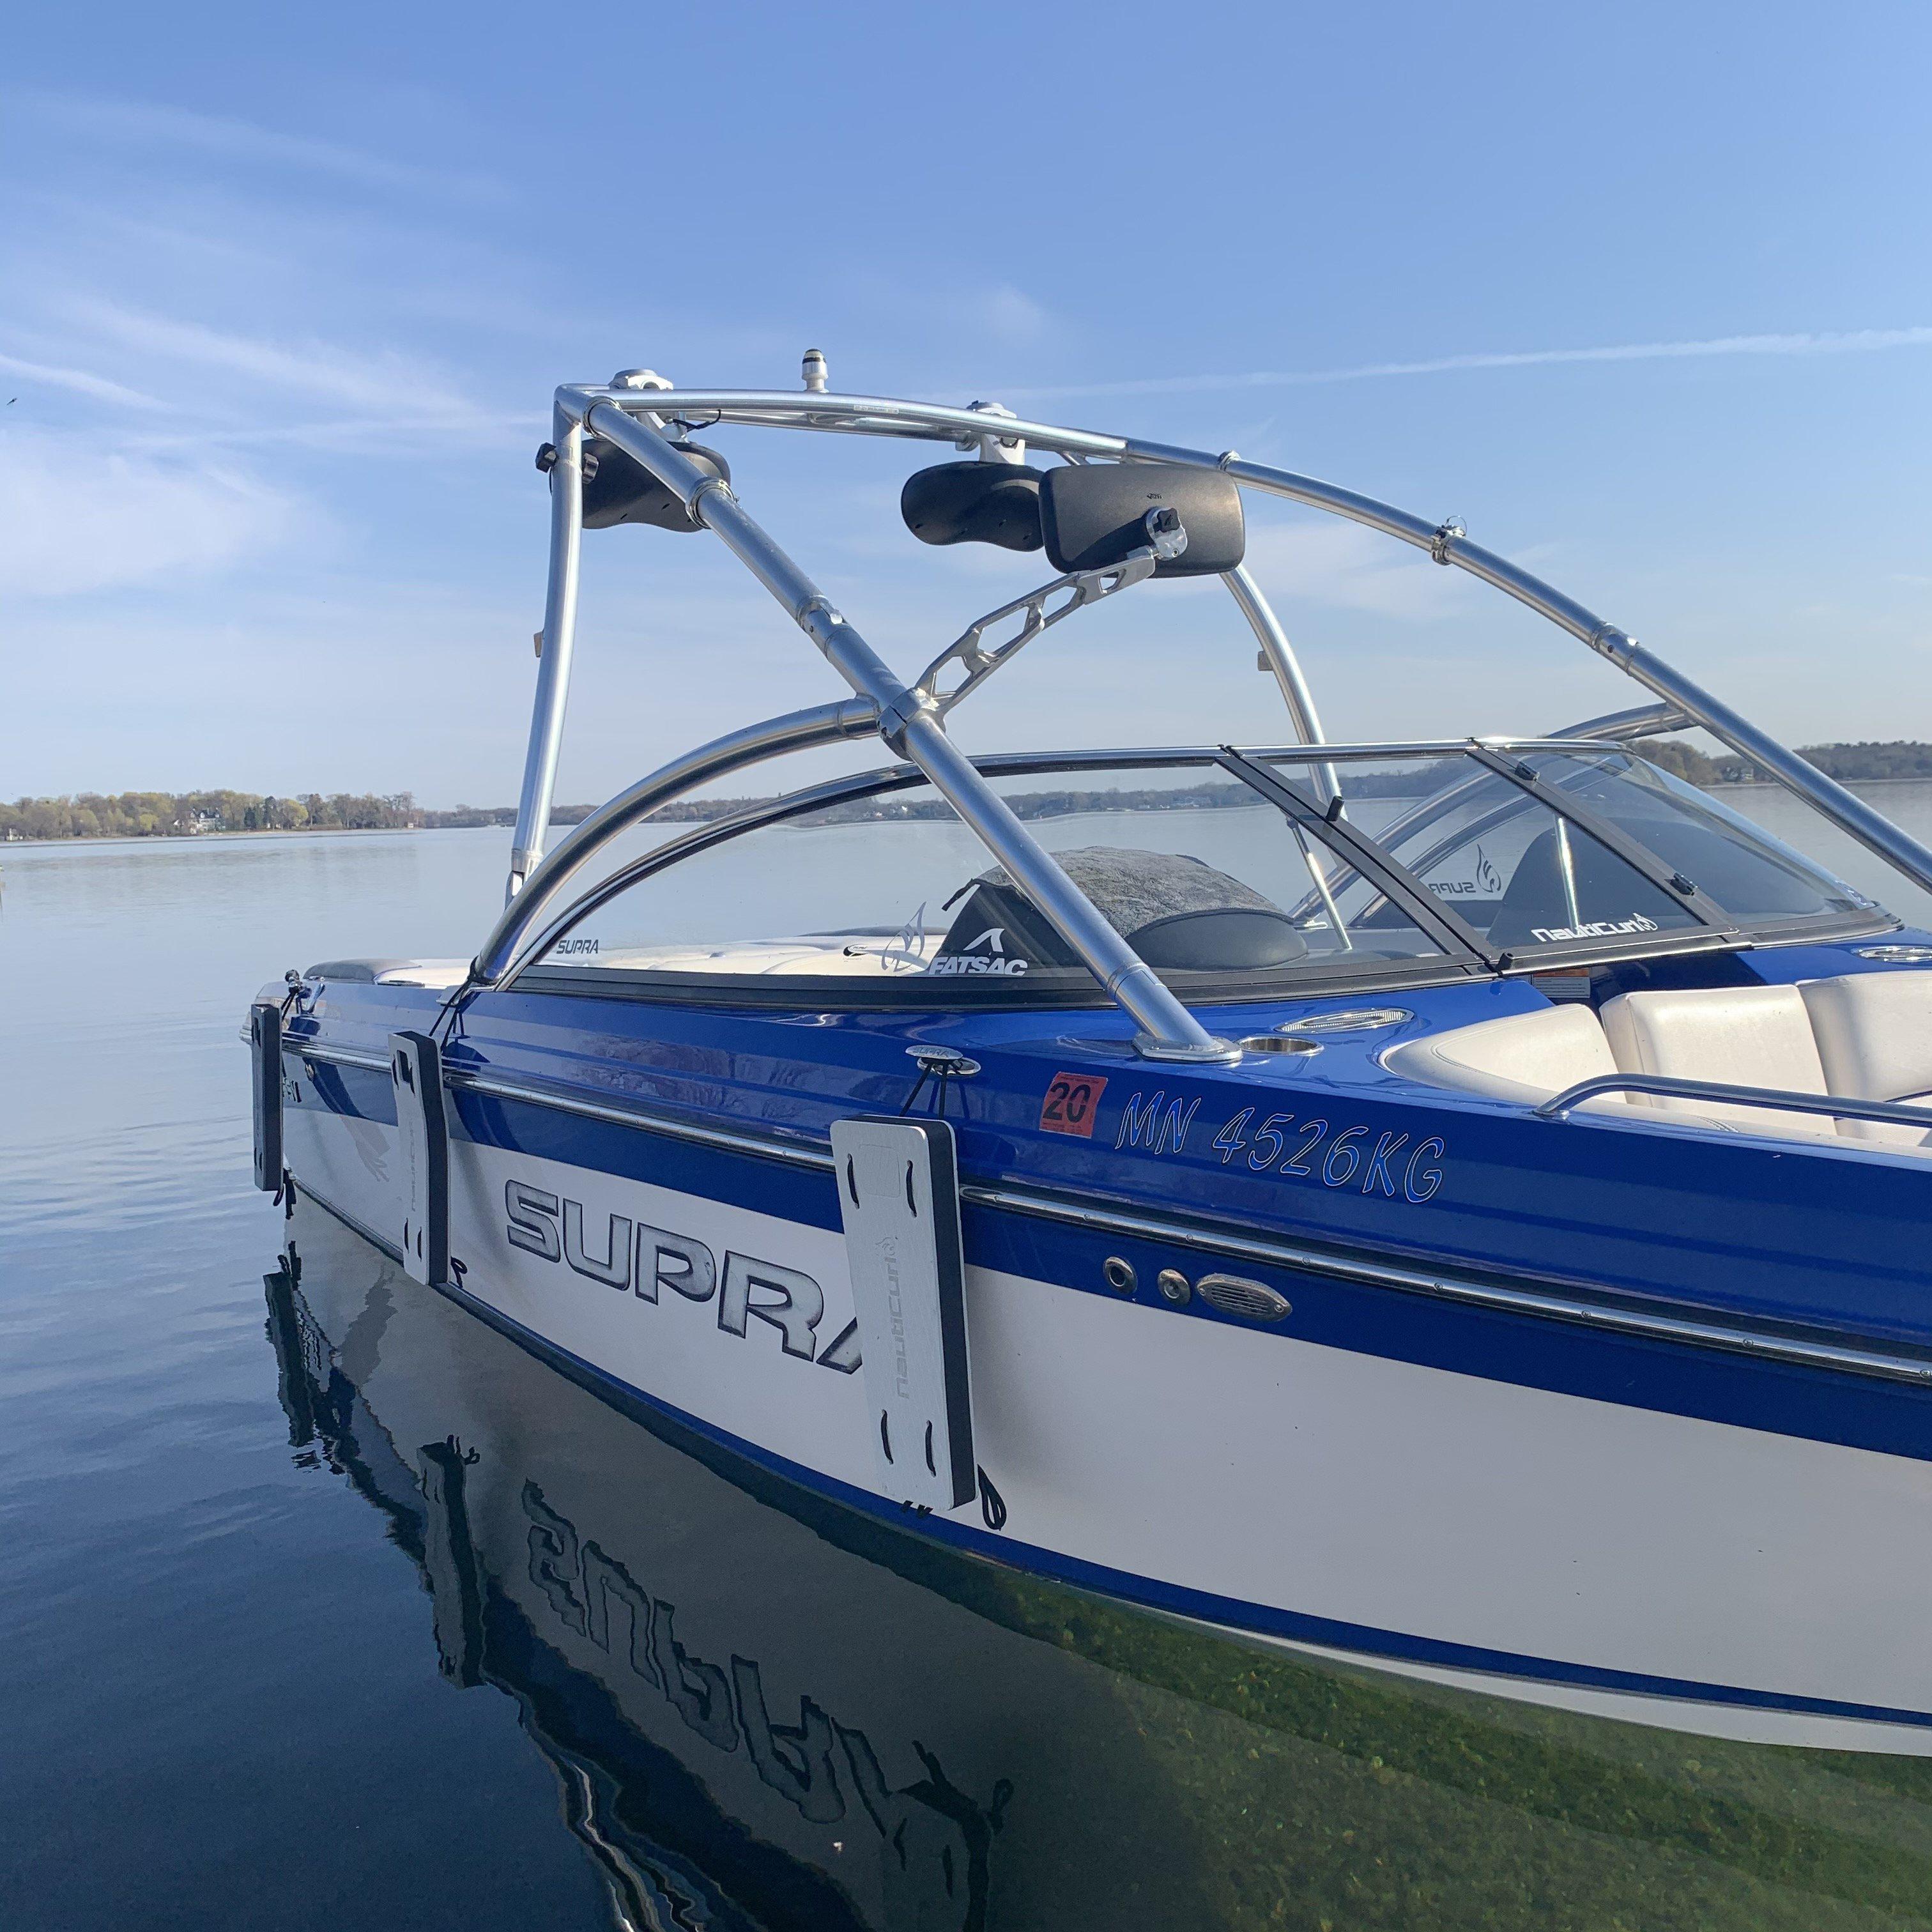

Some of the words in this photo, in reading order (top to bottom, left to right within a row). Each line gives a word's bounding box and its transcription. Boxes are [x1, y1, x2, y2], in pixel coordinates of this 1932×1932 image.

[556, 939, 599, 954] SUPRA
[928, 956, 1028, 976] FATSAC
[1043, 1082, 1091, 1123] 20
[1115, 1091, 1201, 1154] MN
